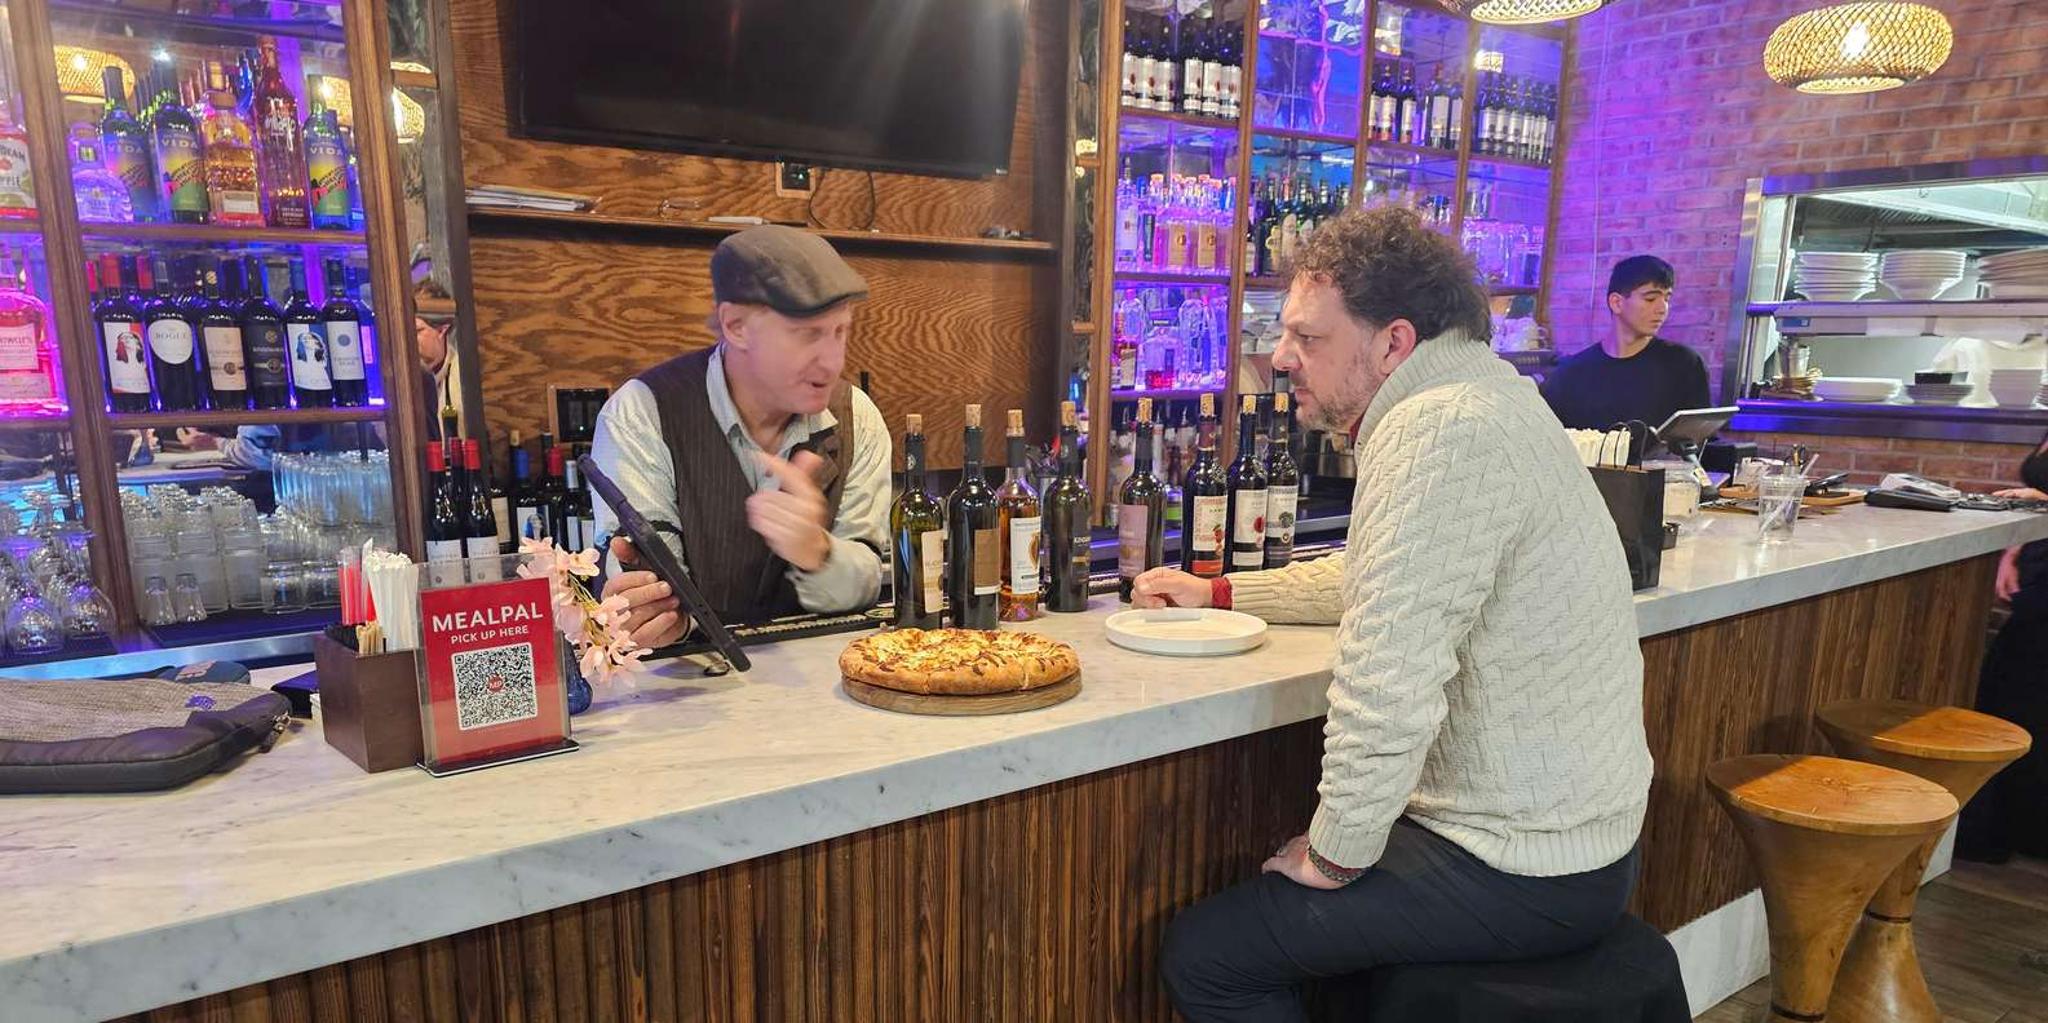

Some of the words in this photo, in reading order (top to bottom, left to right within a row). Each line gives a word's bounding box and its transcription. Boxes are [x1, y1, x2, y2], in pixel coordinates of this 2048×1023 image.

[108, 143, 144, 153] VIDA
[162, 138, 198, 149] VIDA
[310, 147, 343, 156] VIDA
[432, 602, 543, 633] MEALPAL
[451, 633, 478, 644] PICK
[481, 630, 496, 640] UP
[500, 625, 529, 637] HERE
